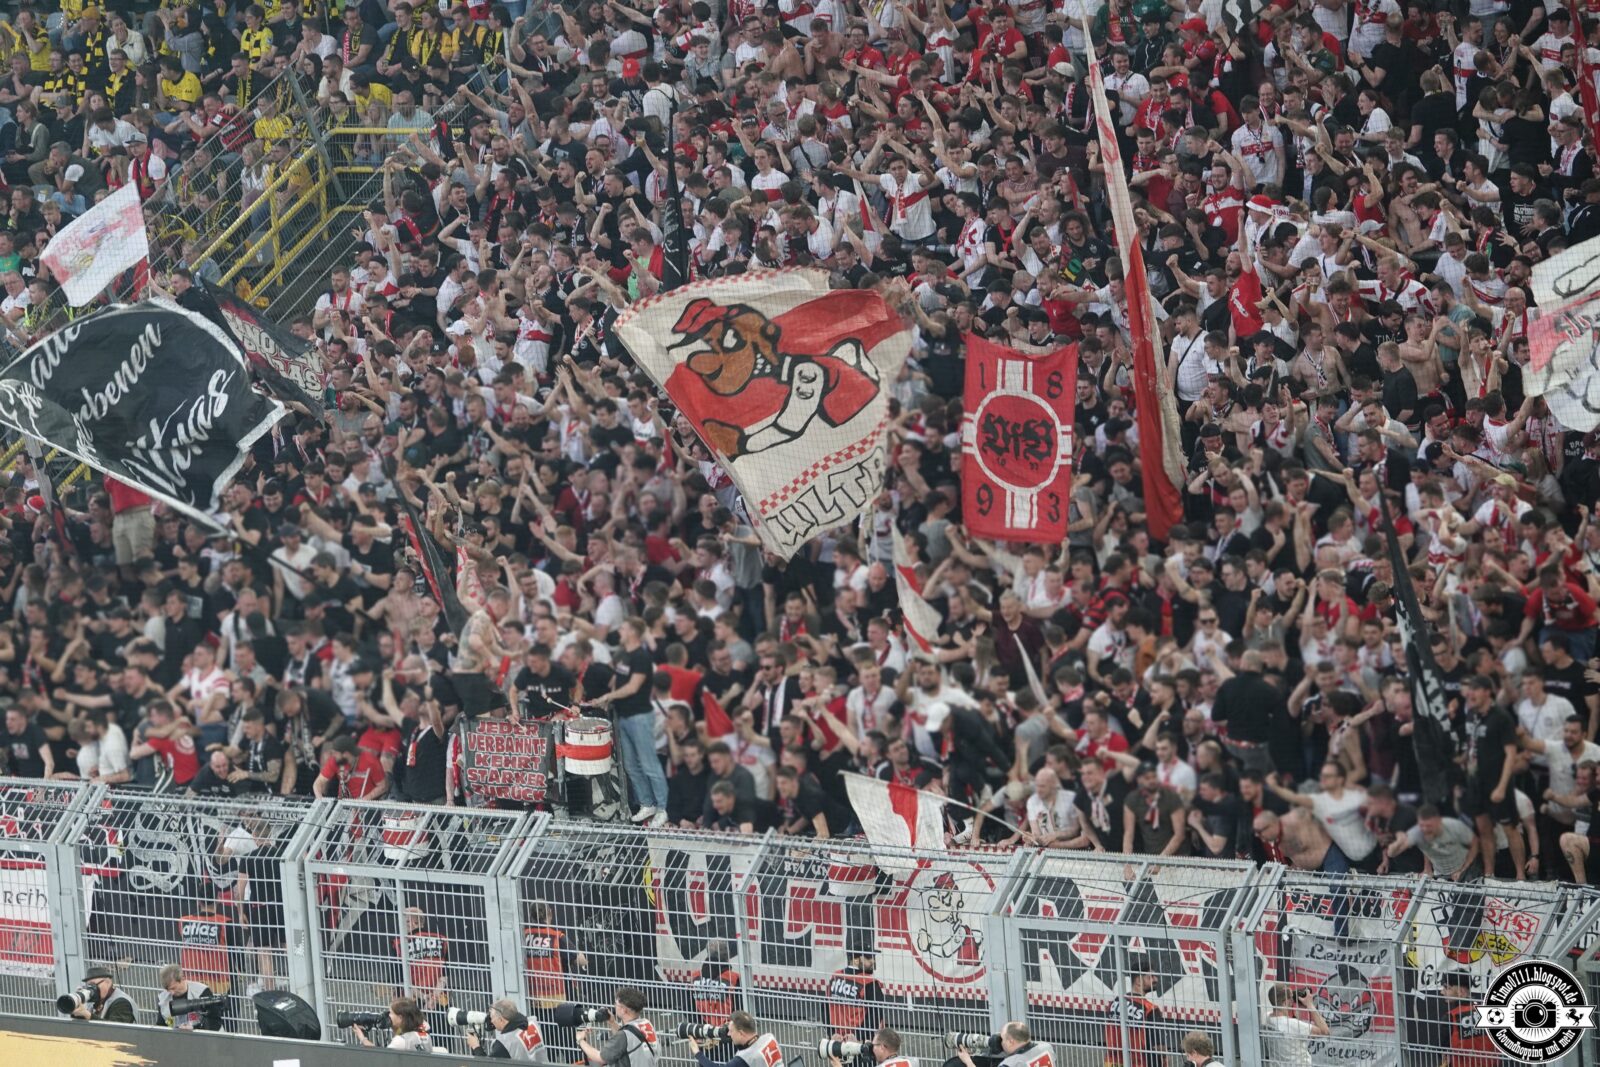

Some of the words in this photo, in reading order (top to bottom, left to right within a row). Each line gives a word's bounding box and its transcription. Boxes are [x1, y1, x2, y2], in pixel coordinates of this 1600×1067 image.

[1047, 370, 1063, 399] 8
[976, 483, 994, 516] 9
[1048, 492, 1061, 523] 3
[476, 719, 540, 737] JEDER
[466, 732, 548, 757] VERBANNTE
[474, 752, 542, 772] KEHRT
[182, 921, 219, 937] atlas
[525, 934, 551, 948] tlas
